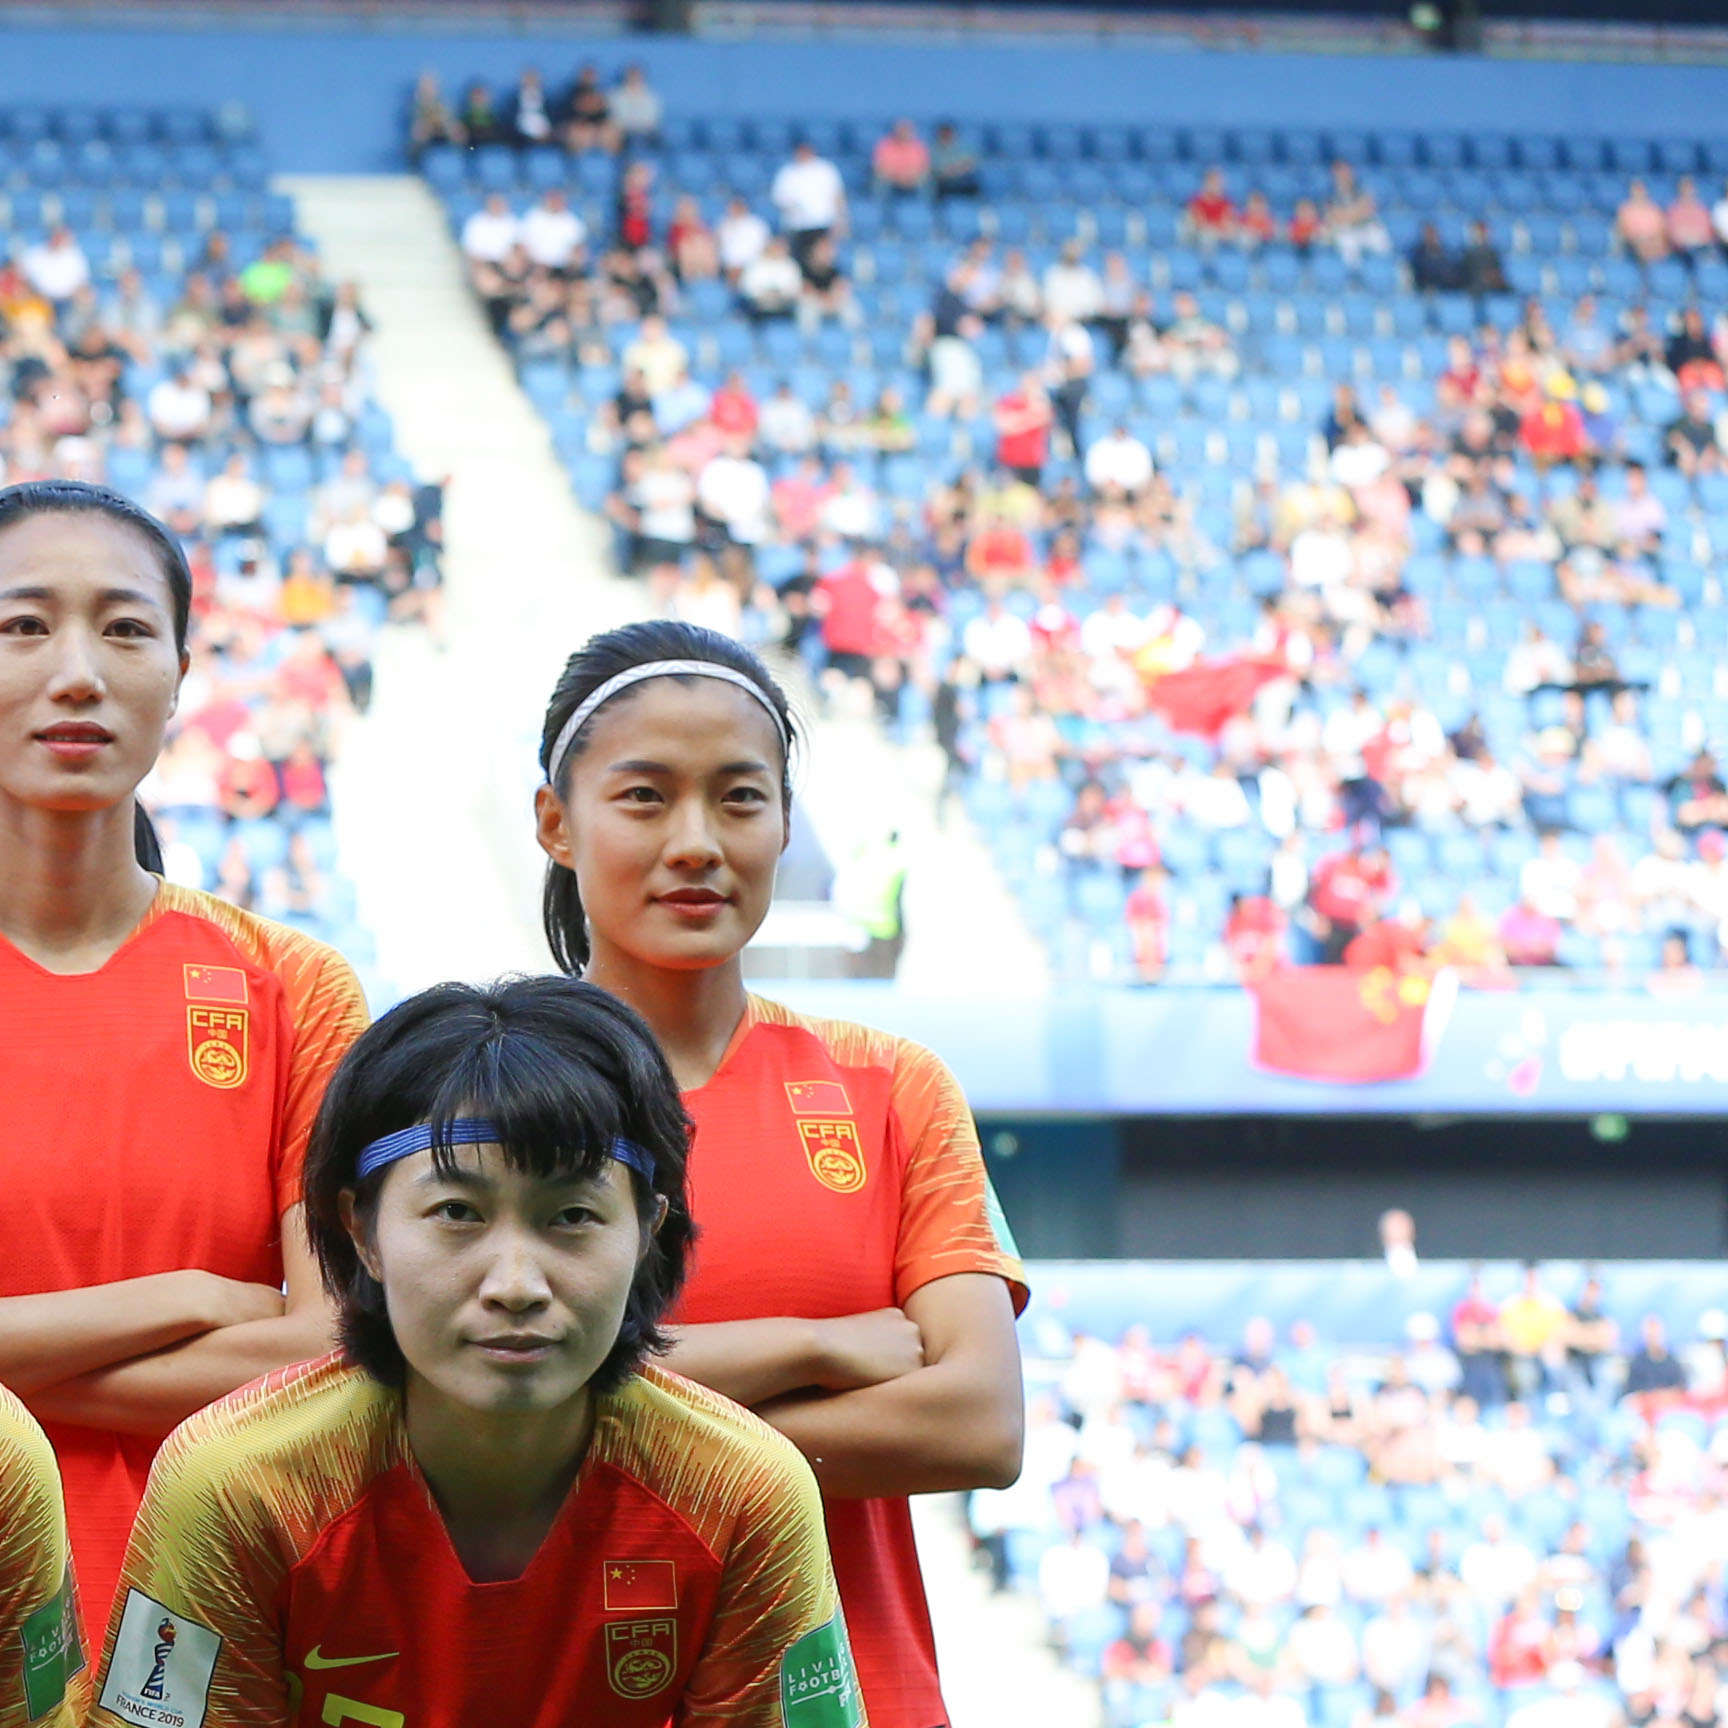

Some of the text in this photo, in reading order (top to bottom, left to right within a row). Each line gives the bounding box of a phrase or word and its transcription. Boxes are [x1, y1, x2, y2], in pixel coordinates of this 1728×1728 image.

[192, 1010, 243, 1031] CFA
[802, 1123, 853, 1140] CFA
[611, 1622, 671, 1640] CFA
[115, 1693, 157, 1720] FRANCE
[157, 1711, 185, 1728] 2019
